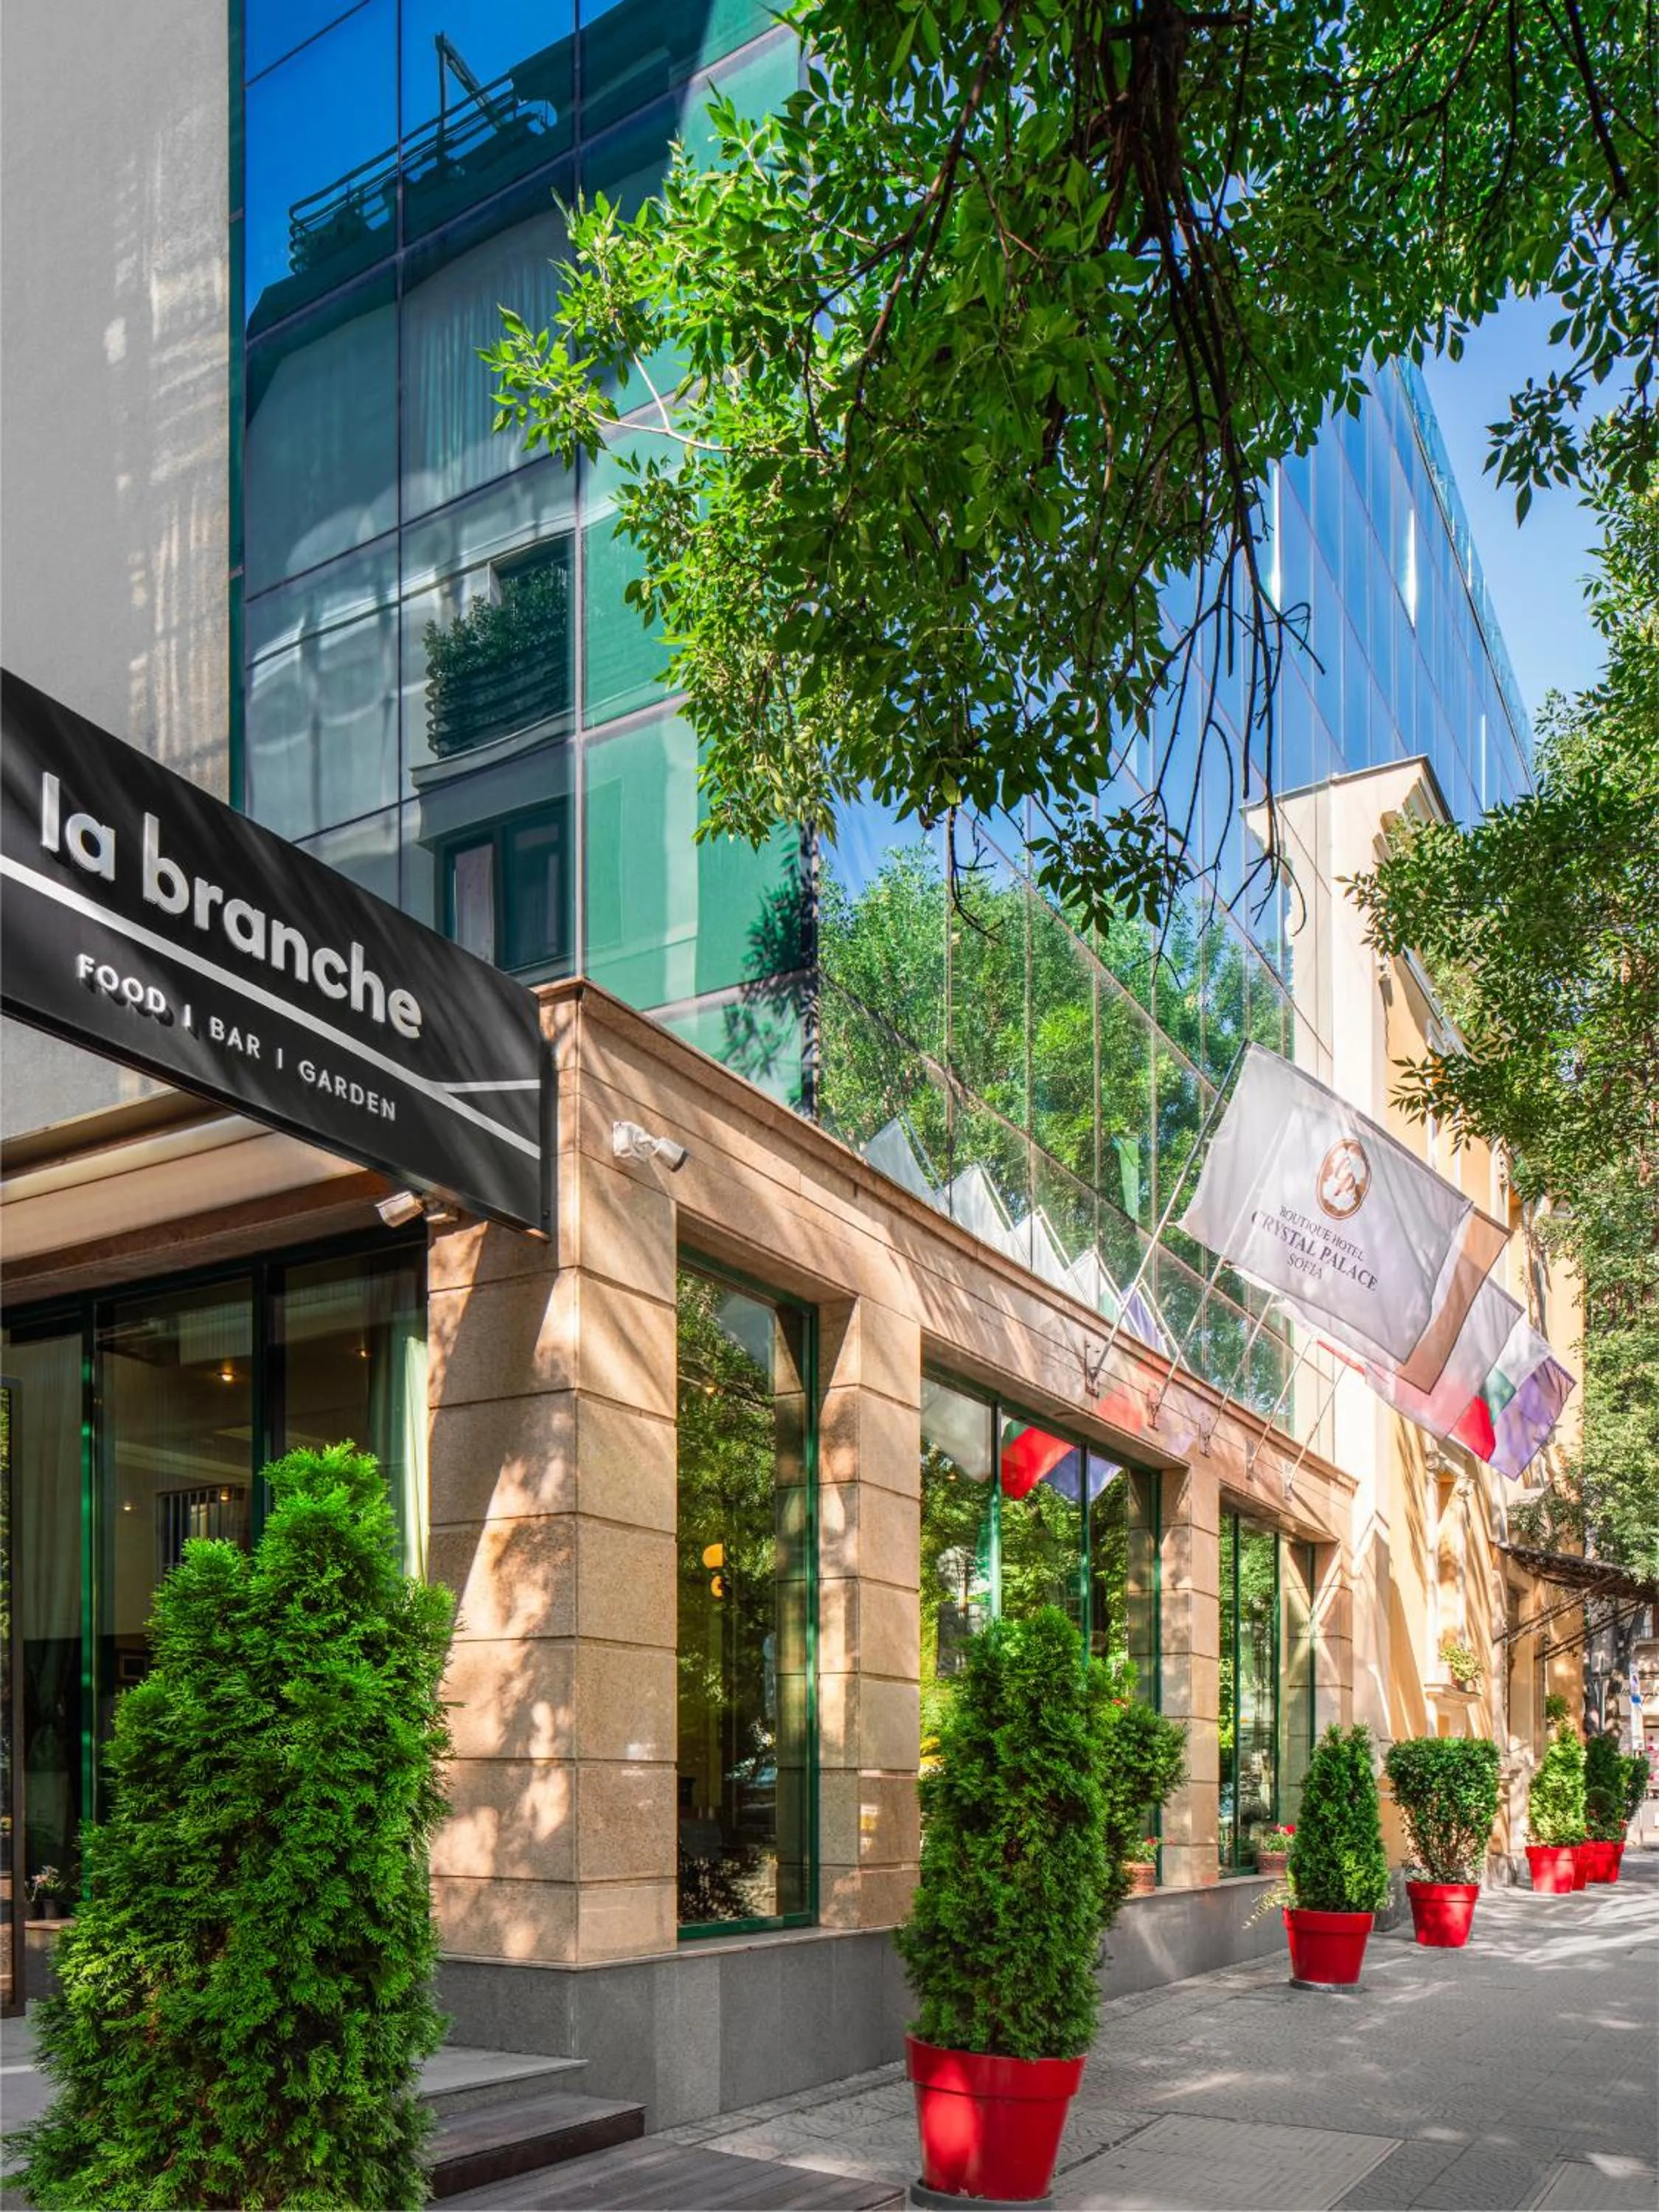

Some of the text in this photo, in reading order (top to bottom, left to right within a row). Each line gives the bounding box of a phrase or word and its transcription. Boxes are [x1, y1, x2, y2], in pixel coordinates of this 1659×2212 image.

[41, 772, 423, 1038] la branche
[76, 953, 167, 1013] FOOD
[209, 1016, 260, 1059] BAR
[298, 1060, 397, 1121] GARDEN
[1251, 1211, 1379, 1291] CRYSTAL PALACE
[1279, 1206, 1364, 1262] BOUTIQUE HOTEL
[1287, 1252, 1323, 1279] SOFIA
